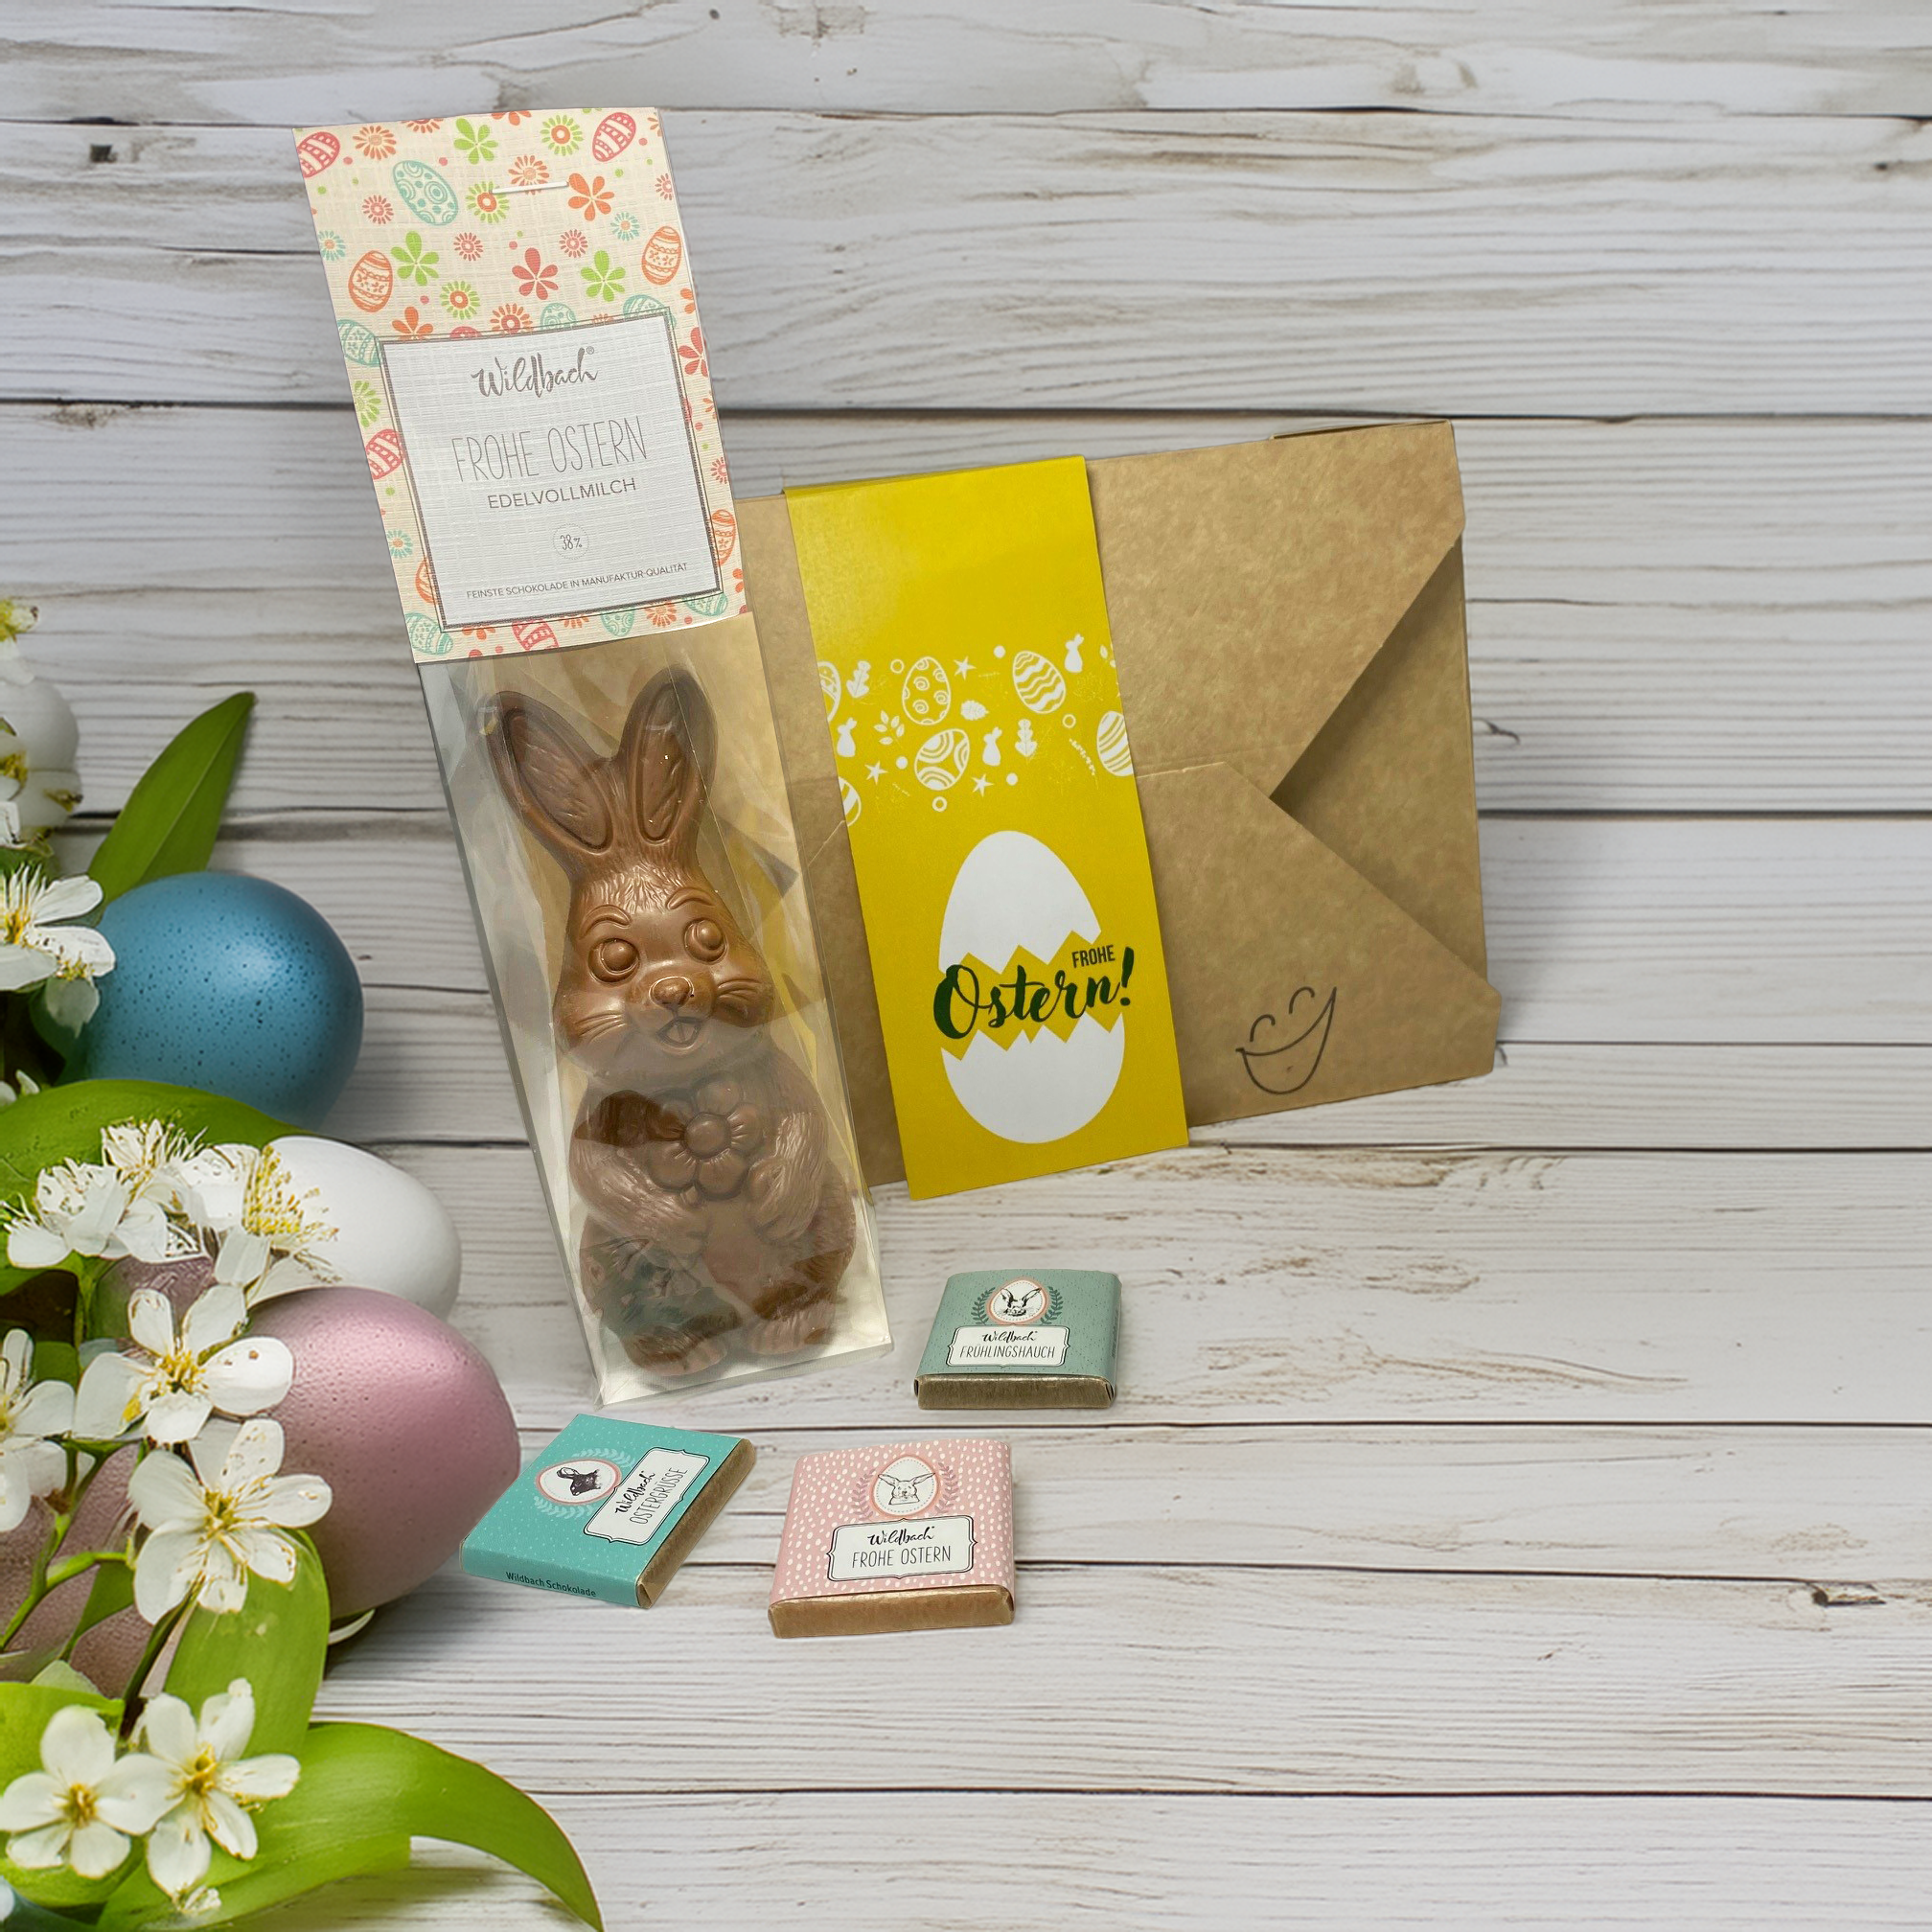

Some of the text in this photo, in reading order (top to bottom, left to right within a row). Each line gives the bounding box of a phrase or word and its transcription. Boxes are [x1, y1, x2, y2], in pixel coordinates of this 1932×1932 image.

[451, 416, 648, 482] FROHE OSTERN
[487, 477, 637, 509] EDELVOLLMILCH
[560, 534, 583, 551] 38%
[466, 587, 504, 599] FEINSTE
[505, 581, 569, 596] SCHOKOLADE
[570, 579, 580, 588] IN
[1071, 944, 1116, 969] FROHE
[932, 946, 1135, 1040] Ostern!
[959, 1344, 1056, 1359] FRÜHLINGSHAUCH
[629, 1466, 689, 1526] OSTERGRÜSSE
[851, 1545, 952, 1569] FROHE OSTERN
[505, 1571, 597, 1598] Wildbach Schokolade
